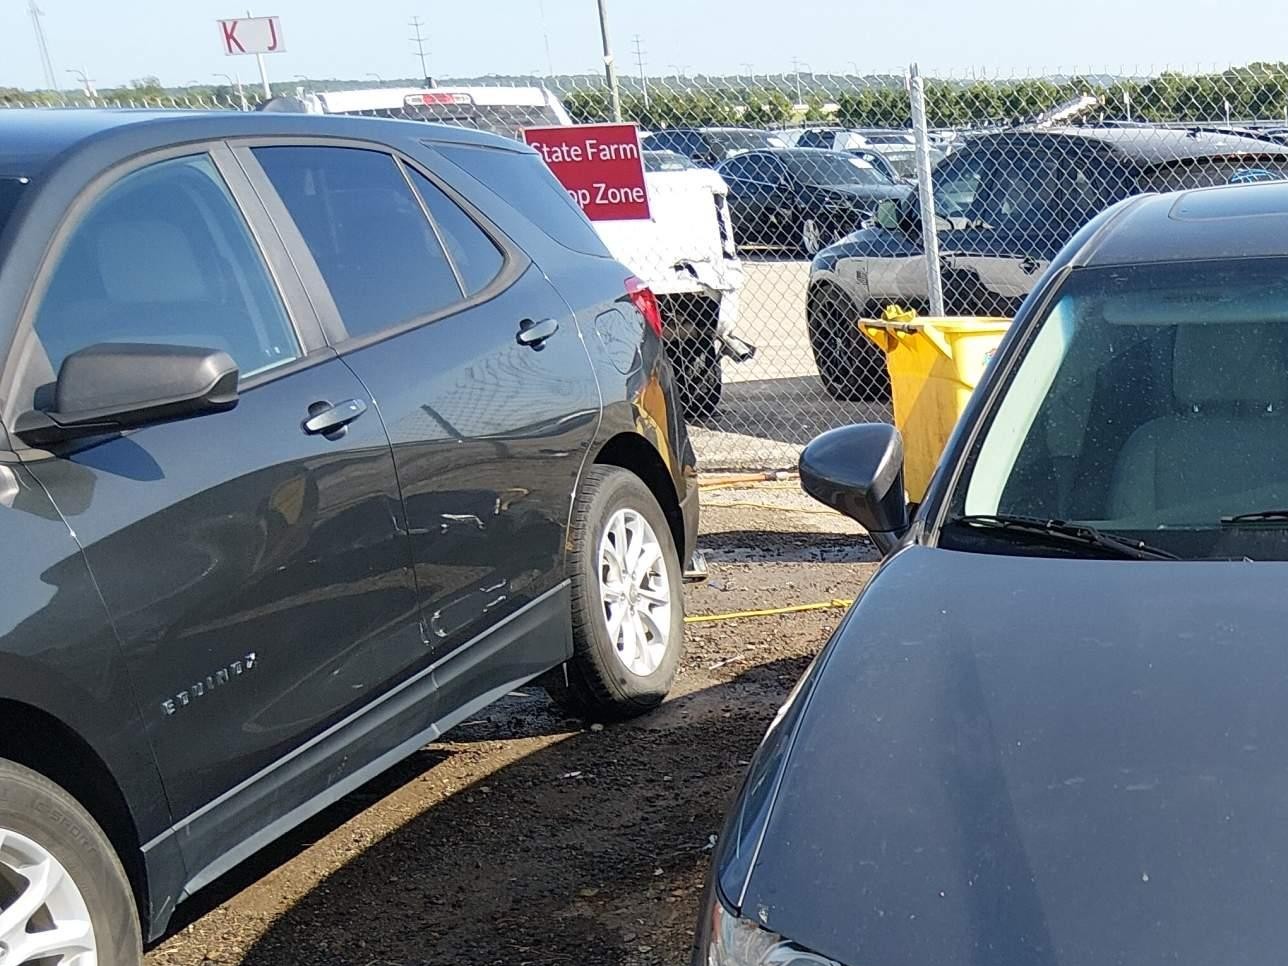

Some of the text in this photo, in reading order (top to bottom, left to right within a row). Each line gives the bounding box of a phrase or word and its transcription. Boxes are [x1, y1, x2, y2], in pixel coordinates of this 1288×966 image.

[222, 19, 278, 53] K J
[585, 140, 638, 161] Farm
[593, 183, 645, 205] Zone
